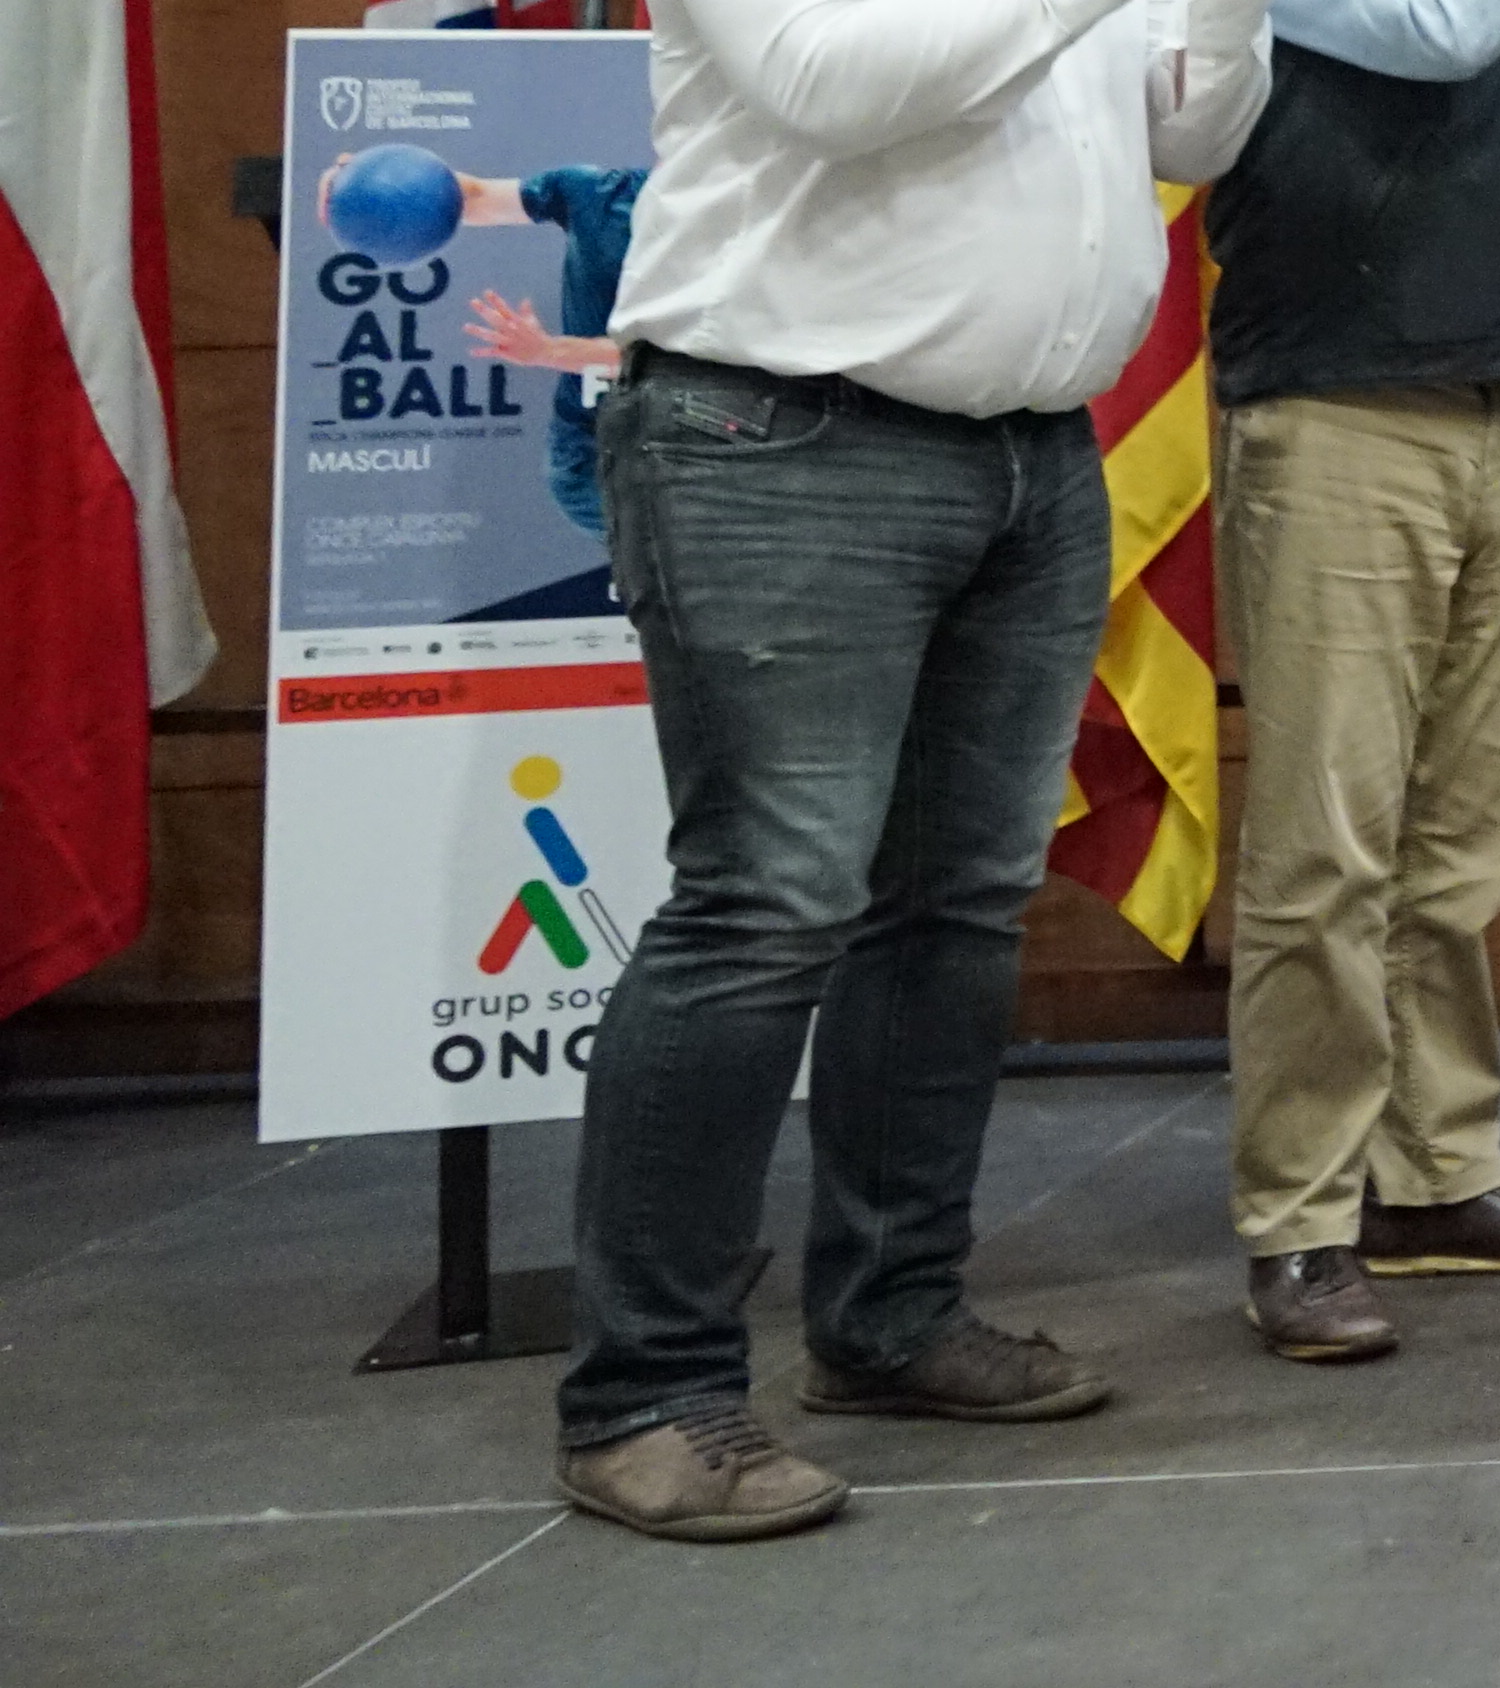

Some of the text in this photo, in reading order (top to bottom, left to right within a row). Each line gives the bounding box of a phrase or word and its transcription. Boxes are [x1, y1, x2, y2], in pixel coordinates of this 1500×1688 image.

[317, 252, 450, 306] GO
[288, 686, 441, 713] Barcelona
[432, 985, 613, 1028] grup soc
[432, 1024, 599, 1083] ONC
